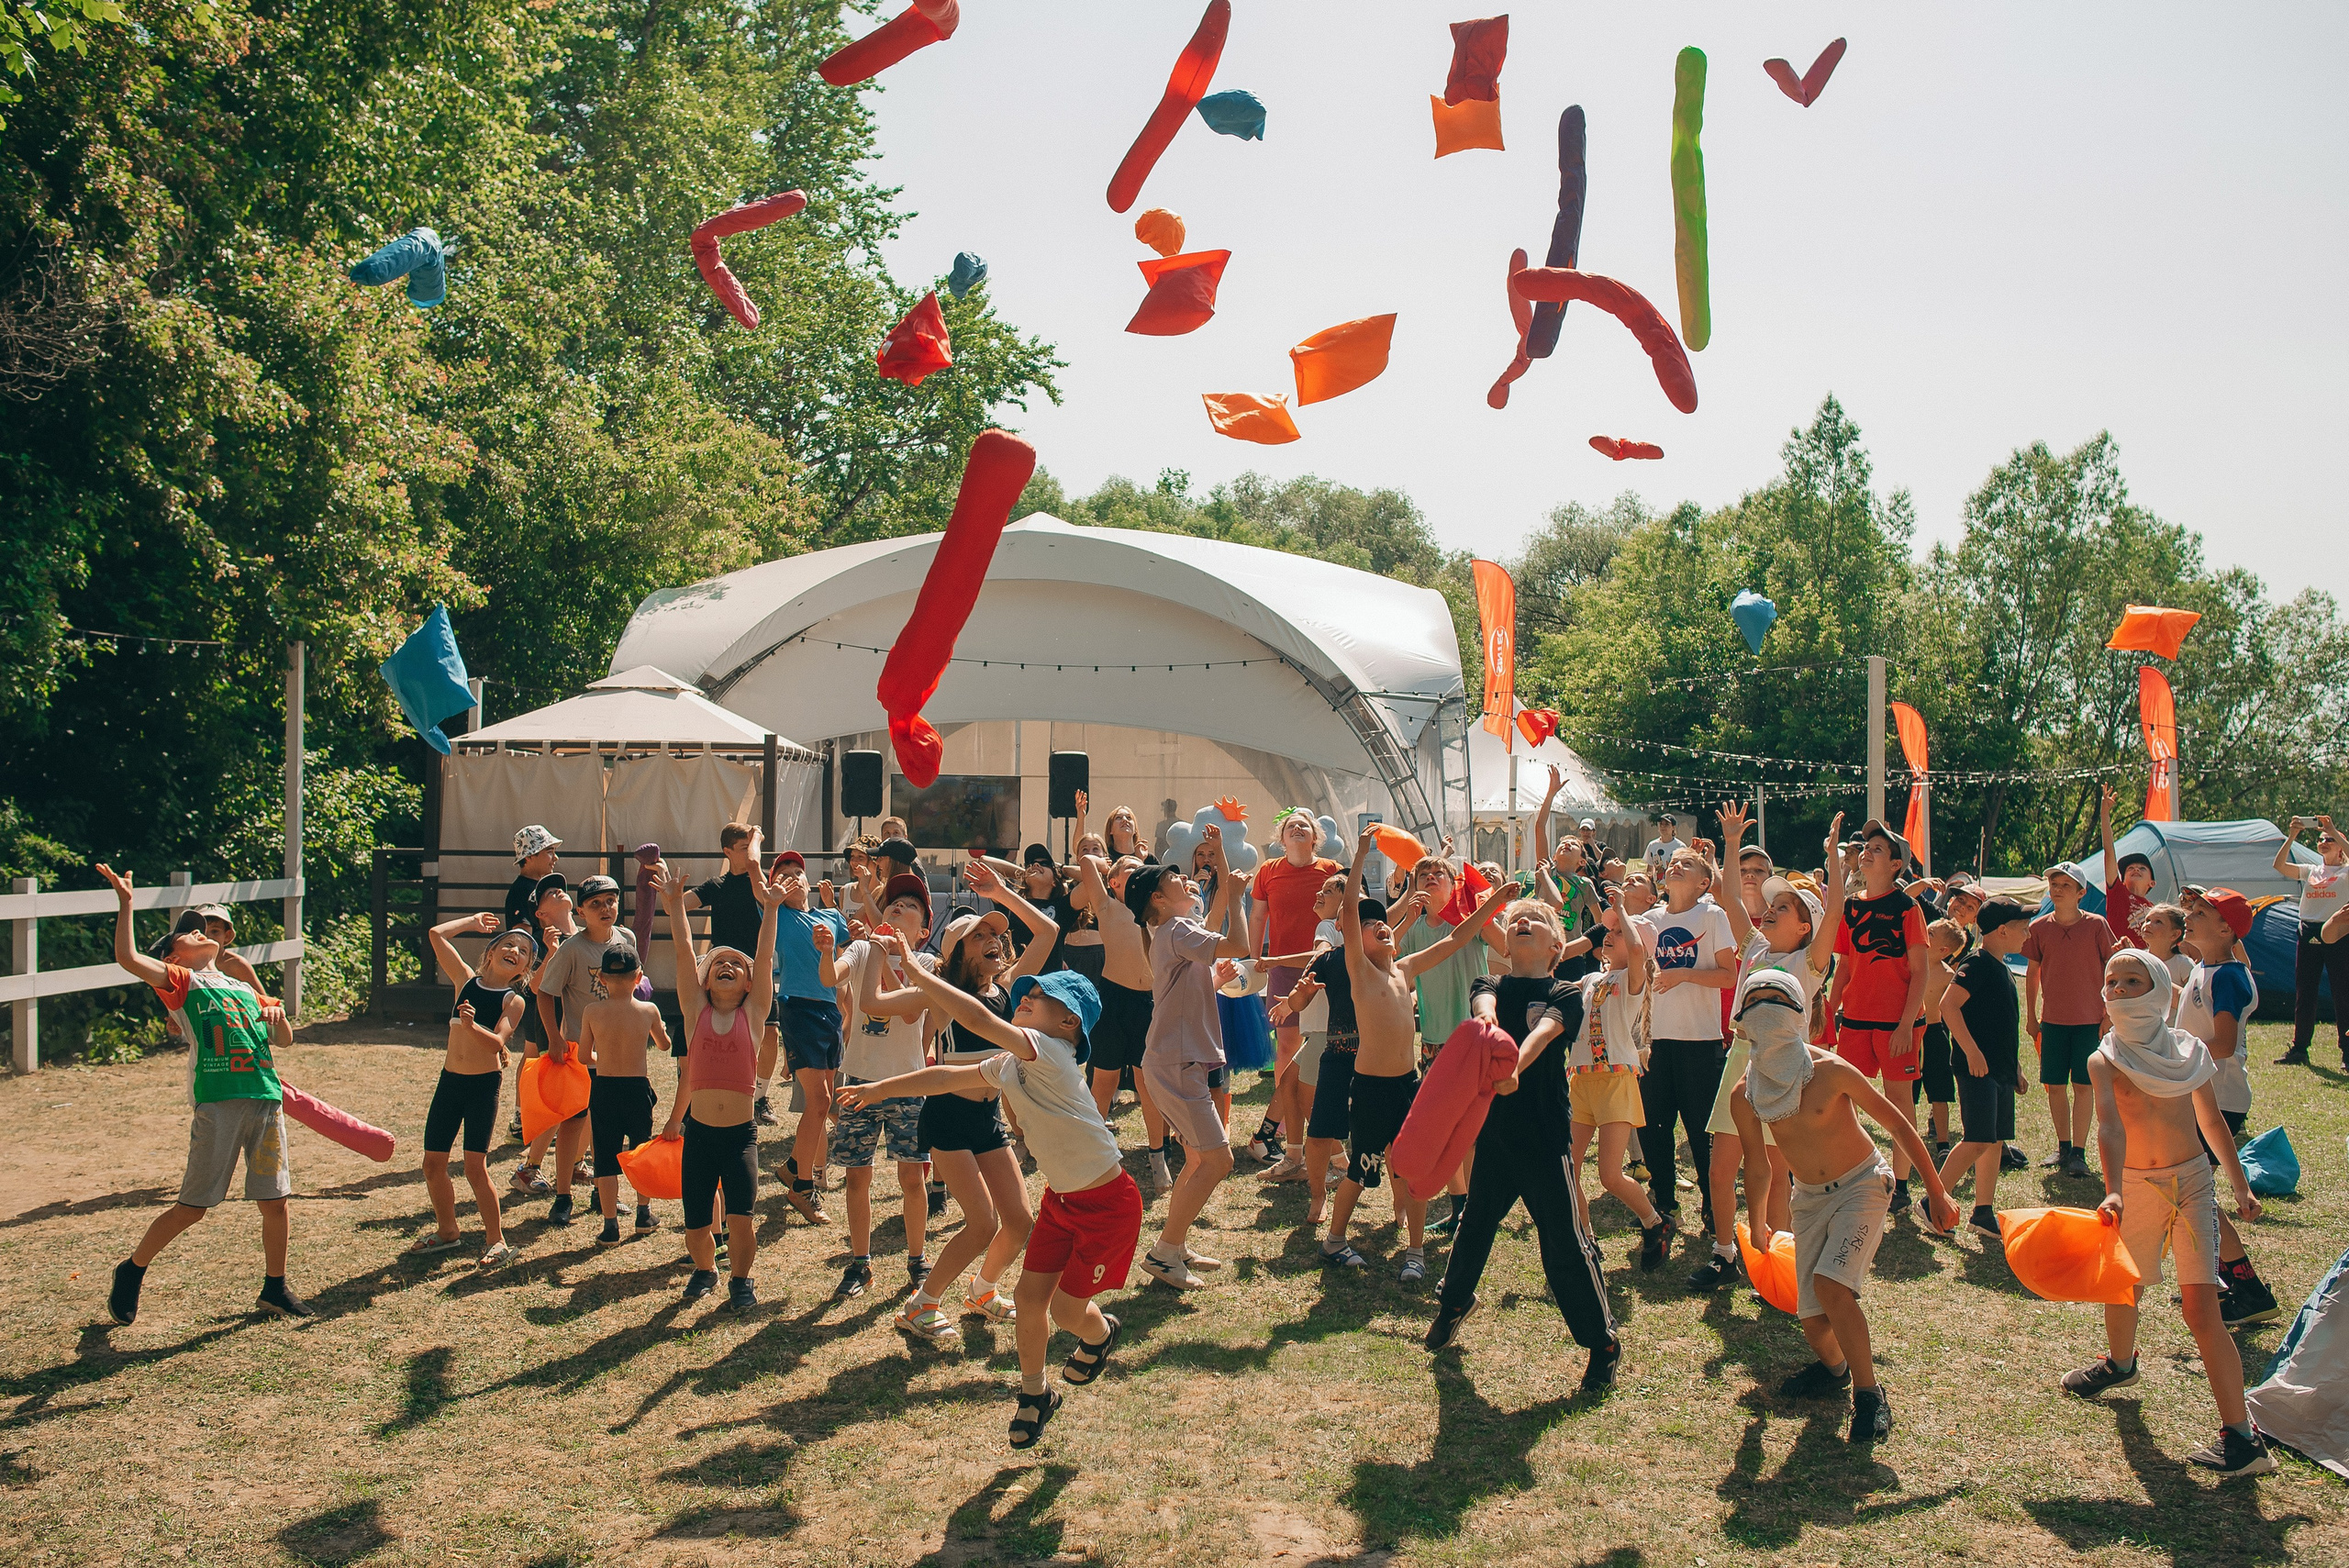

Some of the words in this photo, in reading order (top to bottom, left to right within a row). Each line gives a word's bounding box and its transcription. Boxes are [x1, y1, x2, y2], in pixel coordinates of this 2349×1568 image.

[2306, 890, 2337, 899] adidas
[1656, 946, 1696, 958] NASA
[196, 999, 220, 1014] LA
[222, 996, 255, 1073] RIDER
[2211, 1207, 2218, 1218] BE
[1849, 1224, 1869, 1253] SURF
[1832, 1237, 1849, 1268] ZONE
[1092, 1263, 1106, 1284] 9
